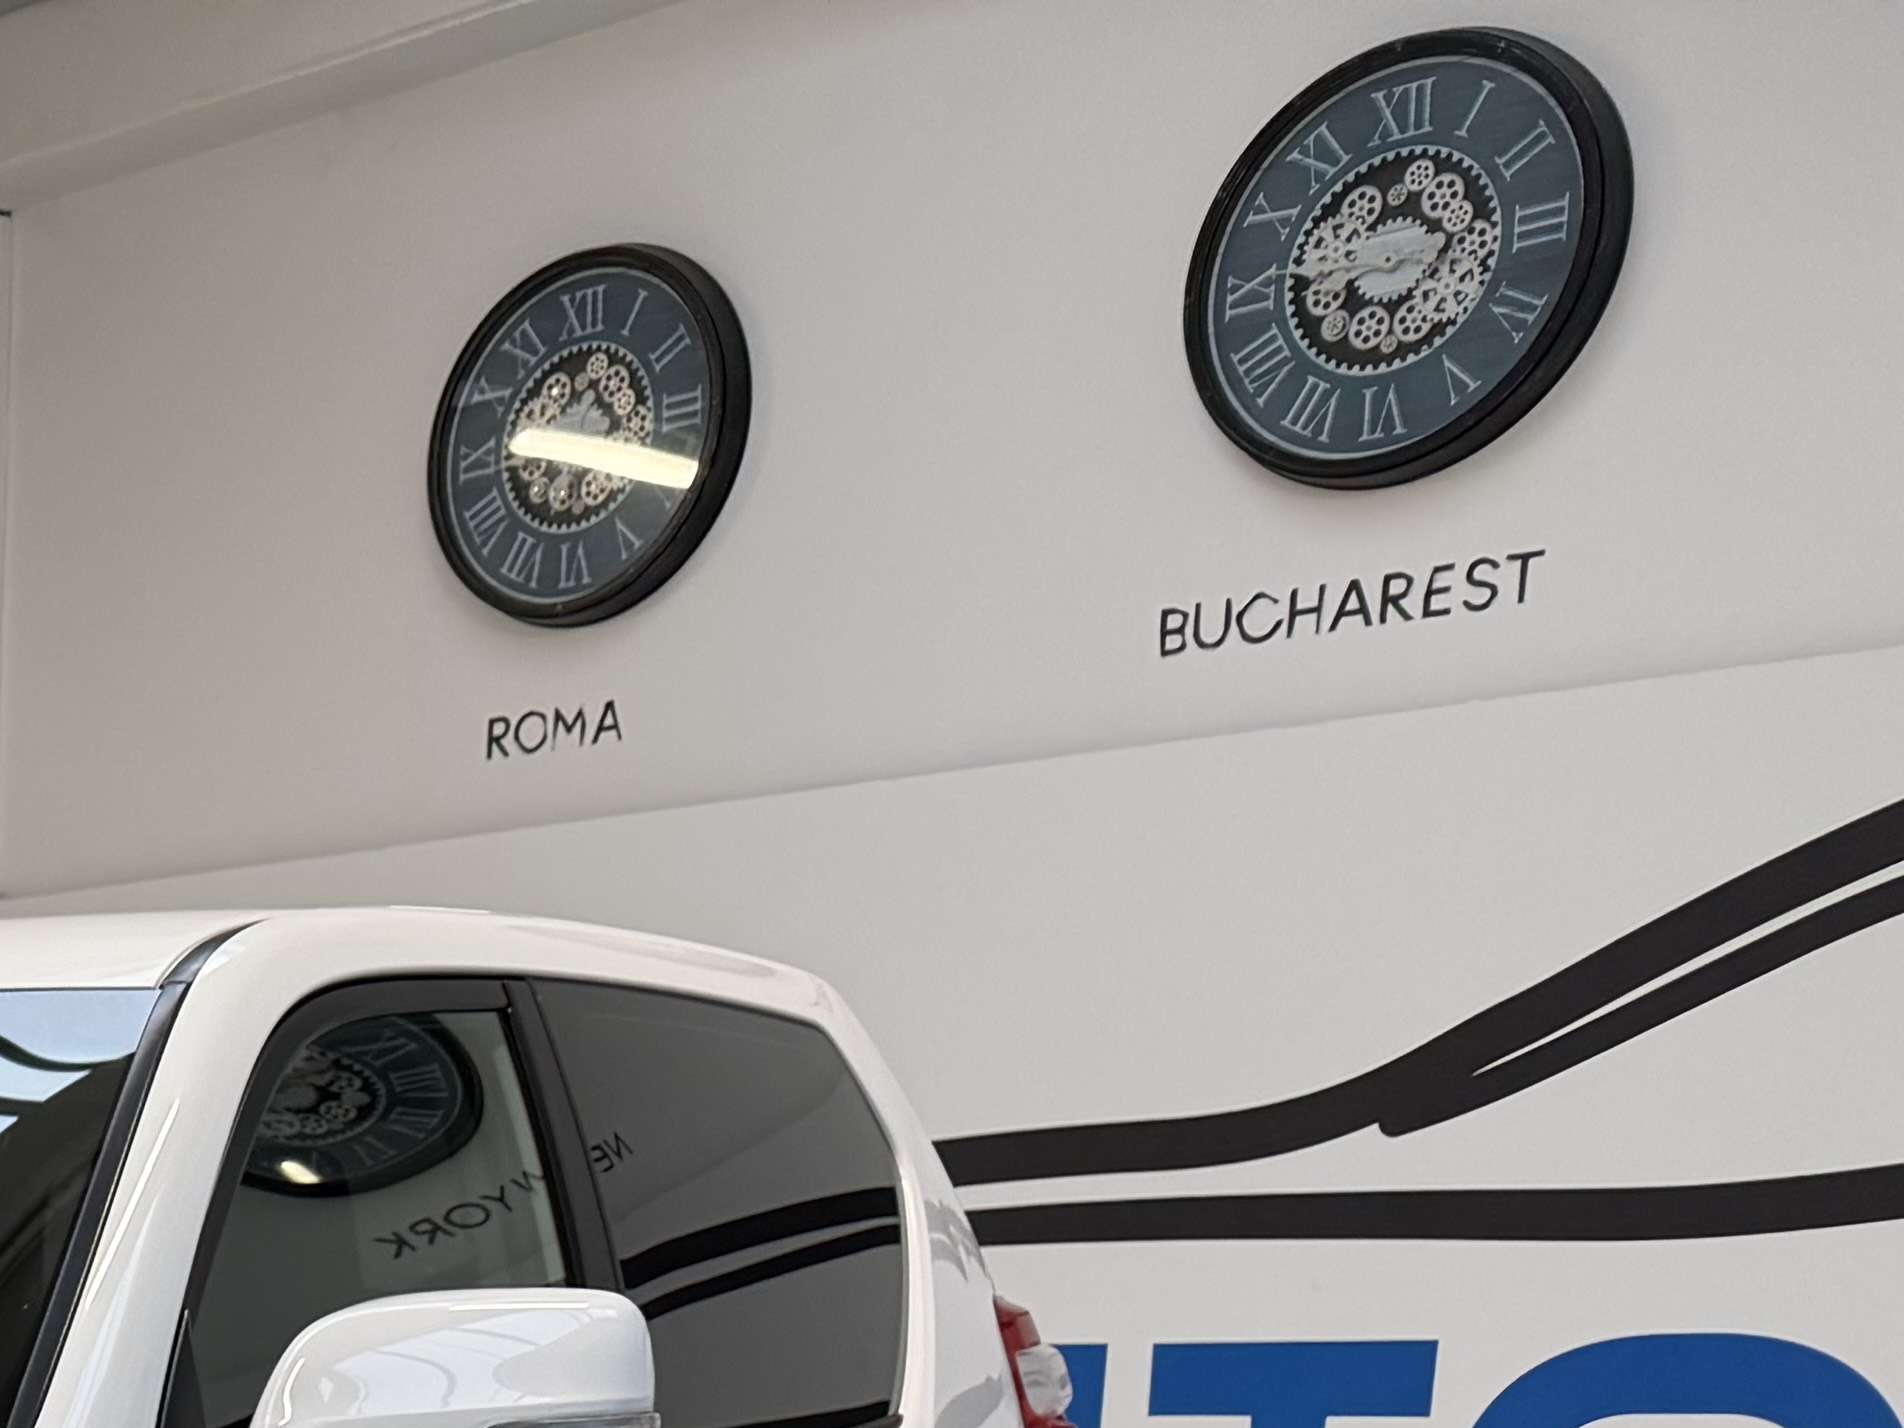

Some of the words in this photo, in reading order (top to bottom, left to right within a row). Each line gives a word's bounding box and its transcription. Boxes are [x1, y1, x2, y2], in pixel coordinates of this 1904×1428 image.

[1368, 76, 1437, 147] XII
[1454, 80, 1496, 137] I
[1286, 121, 1352, 195] XI
[1495, 120, 1556, 181] II
[1244, 192, 1301, 242] X
[1513, 192, 1569, 253] III
[558, 285, 608, 341] XII
[621, 288, 648, 335] I
[1224, 264, 1277, 322] IX
[1489, 282, 1548, 343] IV
[501, 319, 547, 378] XI
[648, 324, 691, 373] II
[1230, 323, 1295, 407] VIII
[473, 377, 512, 417] X
[661, 385, 703, 432] III
[1443, 354, 1481, 405] V
[1281, 376, 1341, 443] VII
[1358, 384, 1407, 442] VI
[459, 437, 505, 485] IX
[465, 490, 510, 557] VIII
[614, 517, 643, 560] V
[501, 531, 545, 588] VII
[558, 541, 592, 587] VI
[1159, 549, 1546, 657] BUCHAREST
[486, 699, 622, 760] ROMA
